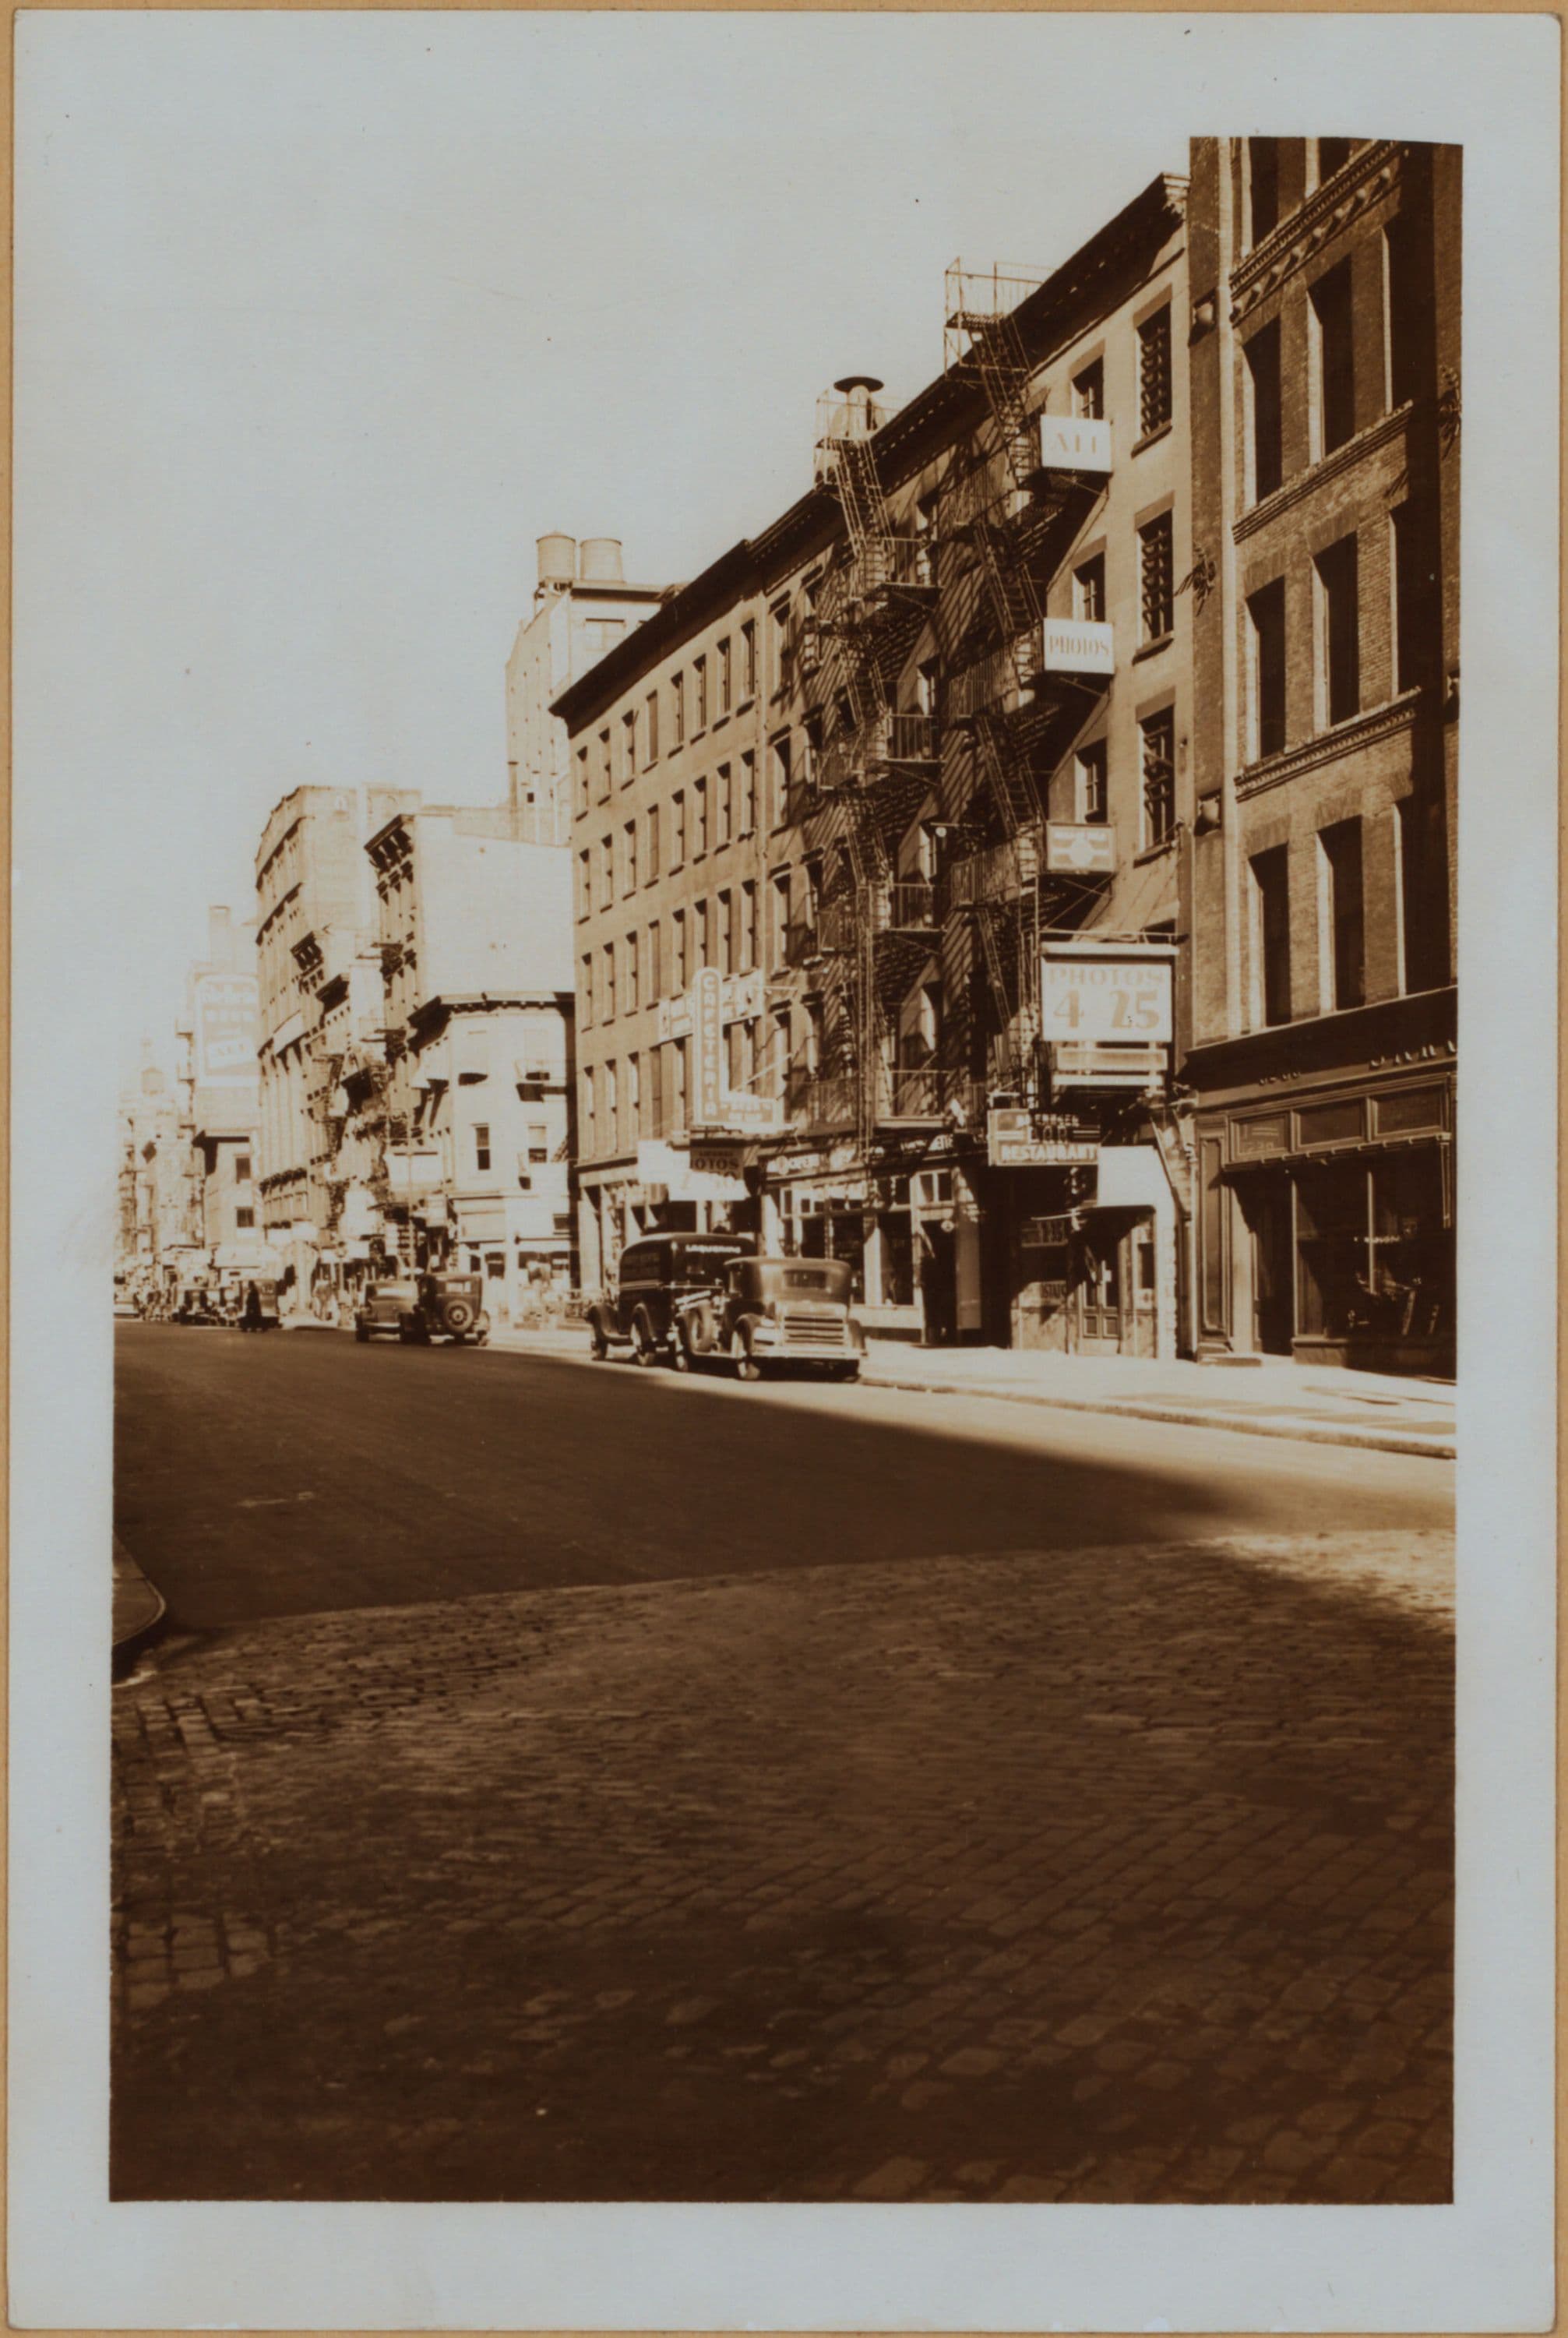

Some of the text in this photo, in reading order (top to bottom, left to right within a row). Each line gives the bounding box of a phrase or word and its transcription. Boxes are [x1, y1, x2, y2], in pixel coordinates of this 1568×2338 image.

[1048, 636, 1109, 655] PHOTOS
[1048, 968, 1164, 986] PHOTOS
[1053, 989, 1160, 1028] 4 25
[704, 976, 717, 1116] CAFETERIA
[1002, 1144, 1097, 1161] RESTAURANT
